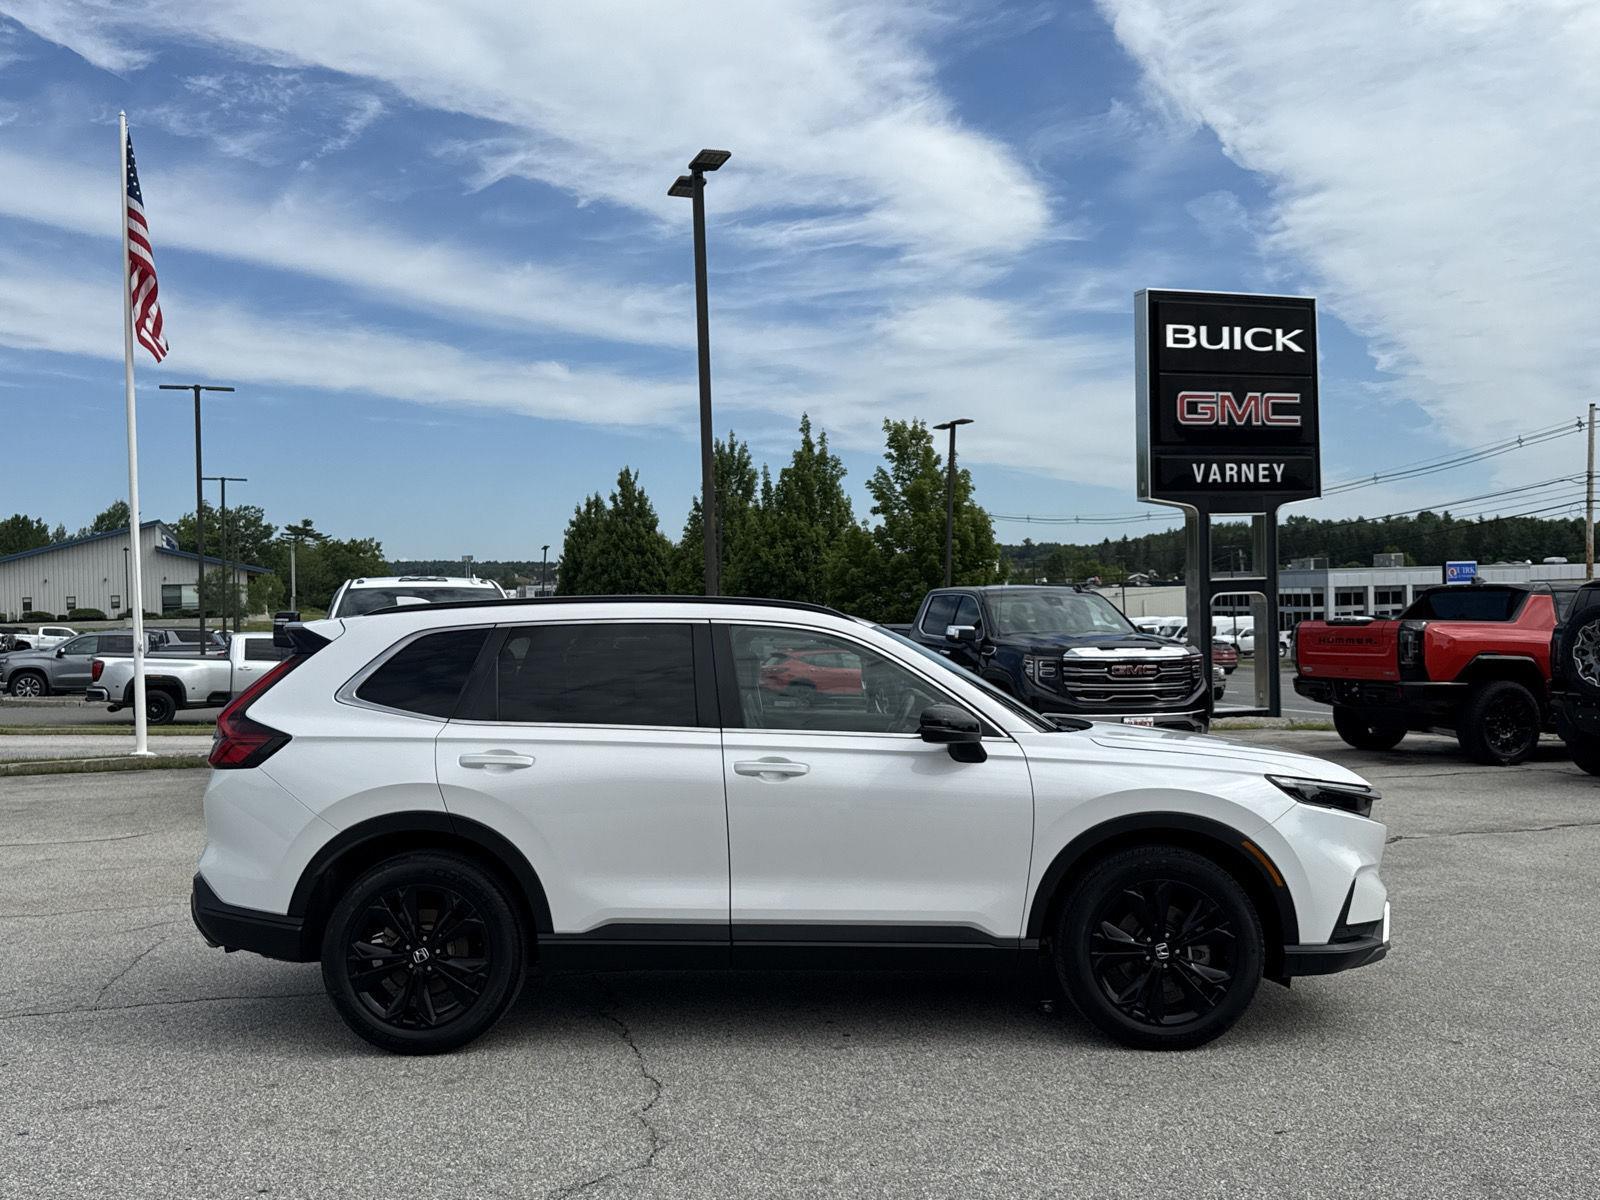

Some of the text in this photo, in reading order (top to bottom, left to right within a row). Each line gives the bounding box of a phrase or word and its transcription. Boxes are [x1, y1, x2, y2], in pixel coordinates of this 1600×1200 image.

[1165, 323, 1306, 353] BUICK
[1176, 390, 1302, 427] GMC
[1191, 462, 1286, 484] VARNEY
[1111, 664, 1158, 676] GMC
